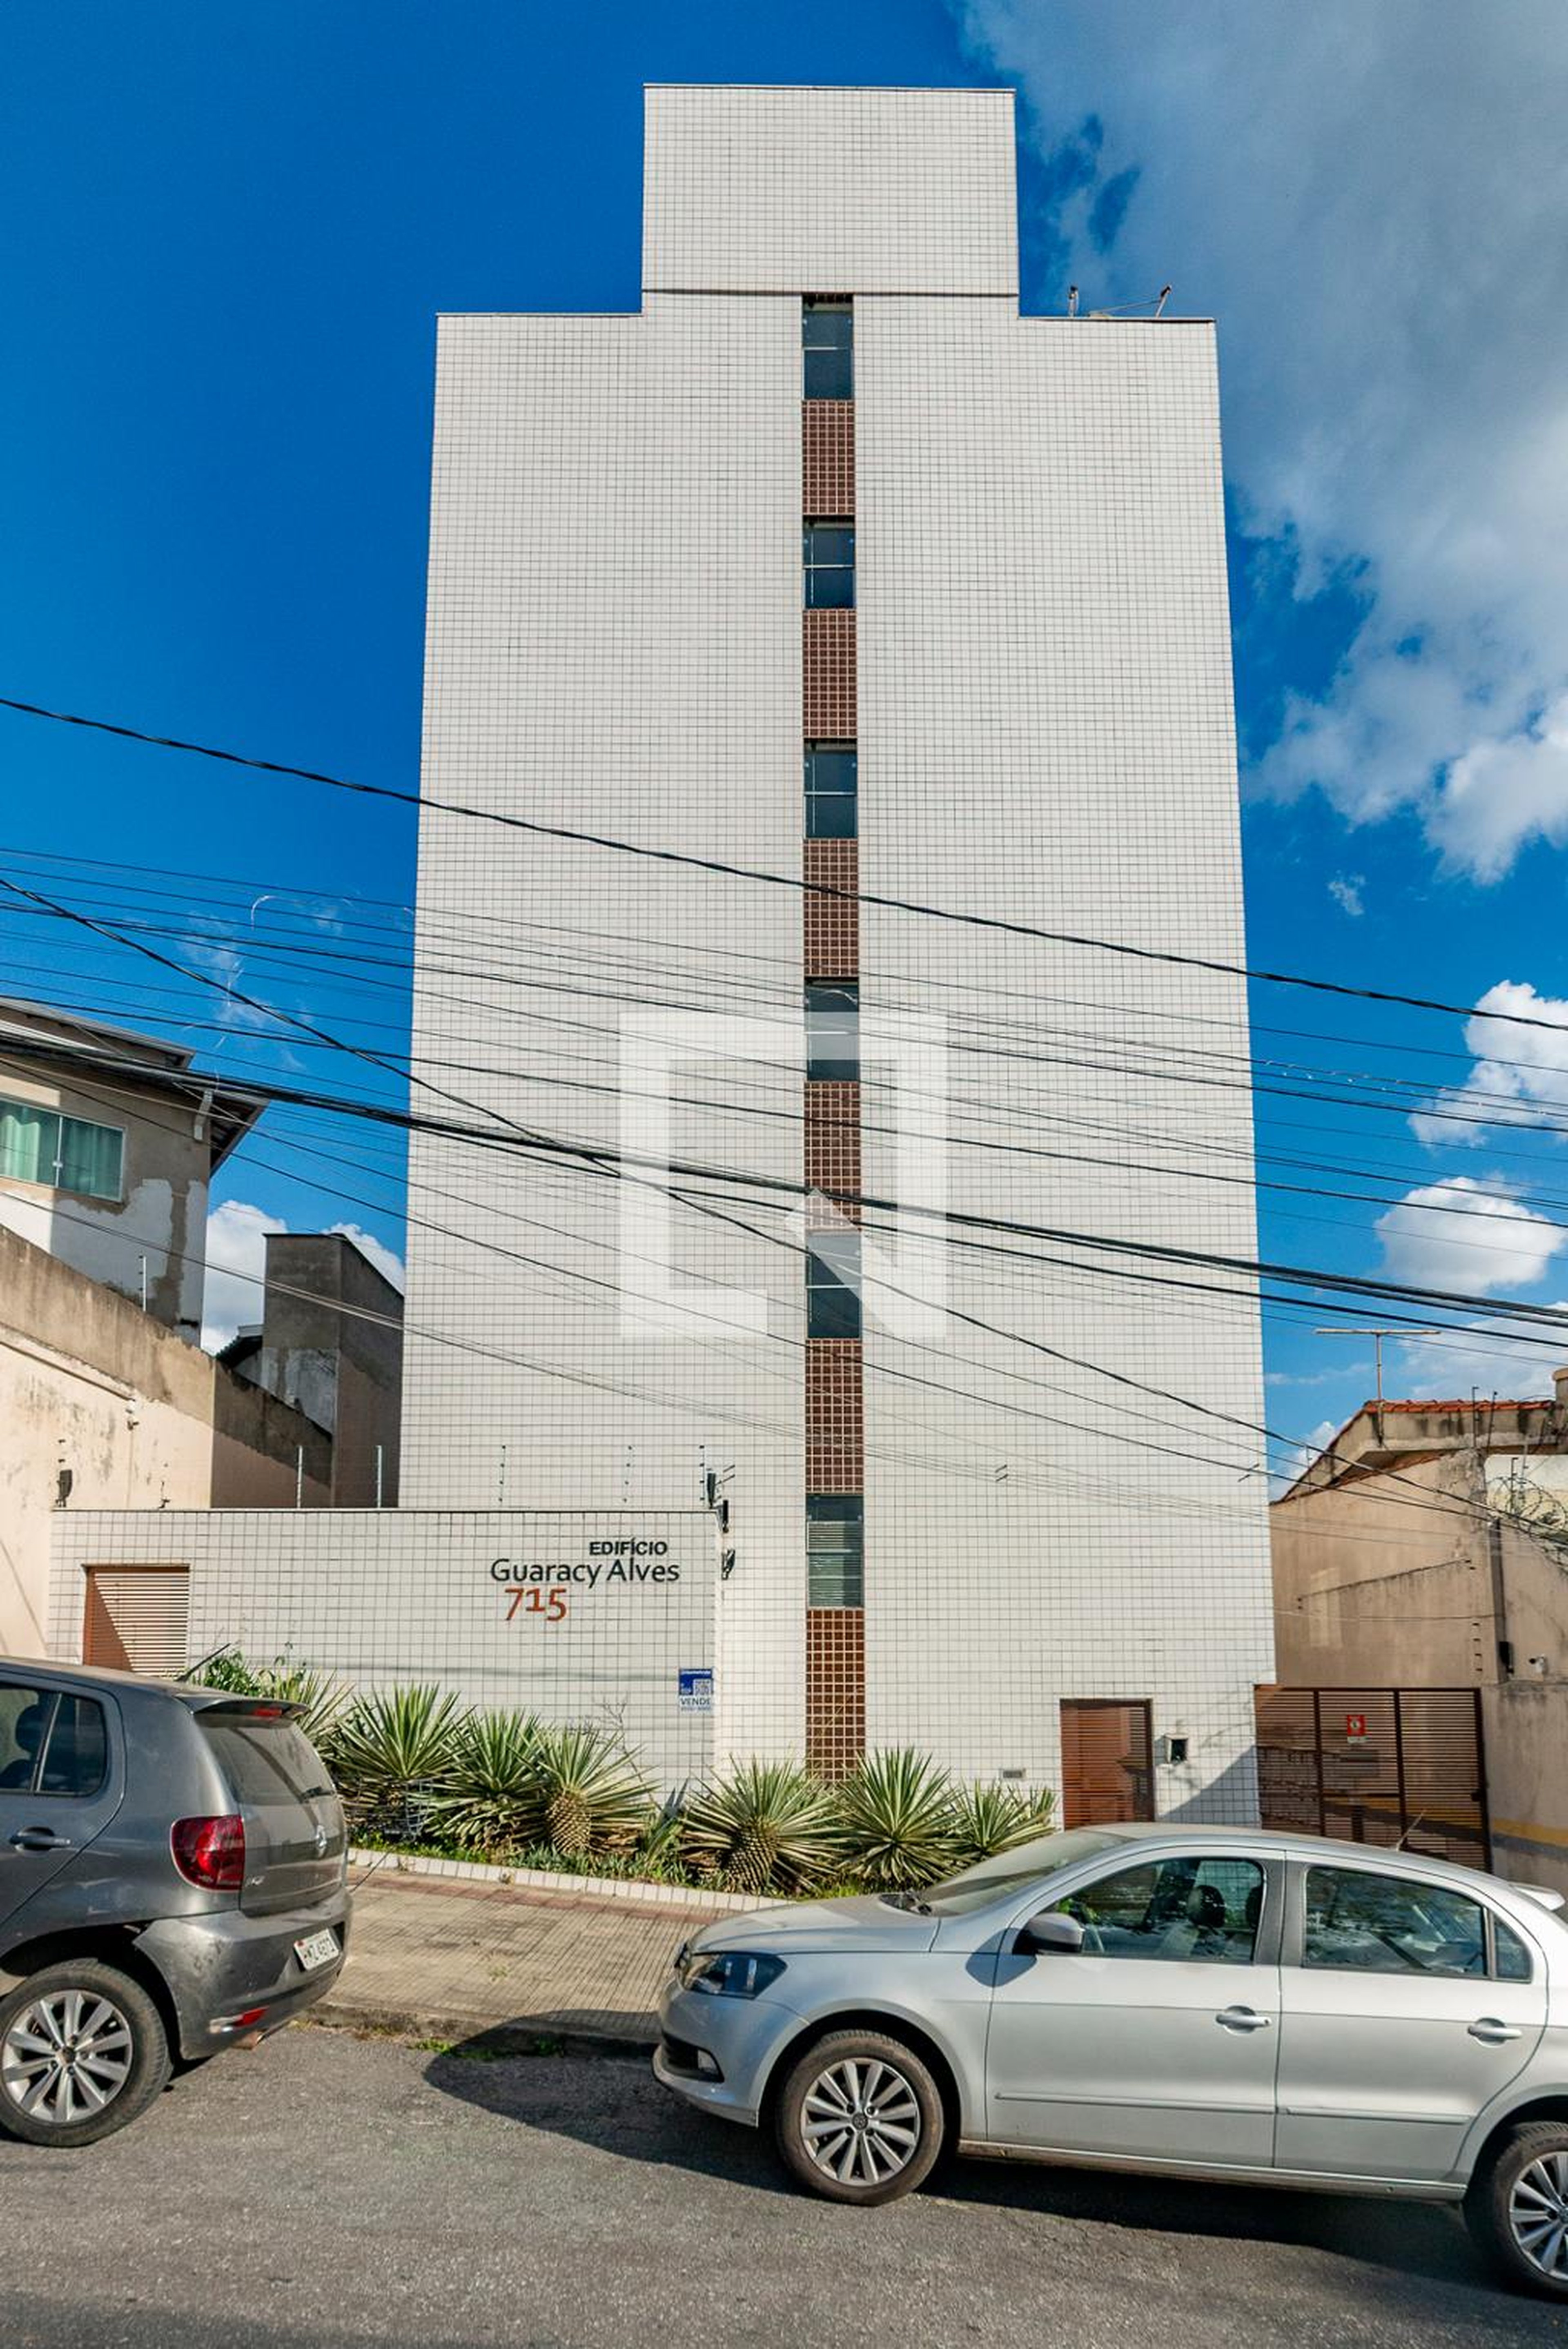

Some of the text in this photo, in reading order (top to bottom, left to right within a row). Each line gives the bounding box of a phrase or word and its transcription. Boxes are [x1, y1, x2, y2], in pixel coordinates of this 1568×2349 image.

[589, 1537, 668, 1555] EDIFÍCIO
[491, 1557, 679, 1589] Guaracy Alves
[505, 1588, 567, 1621] 715
